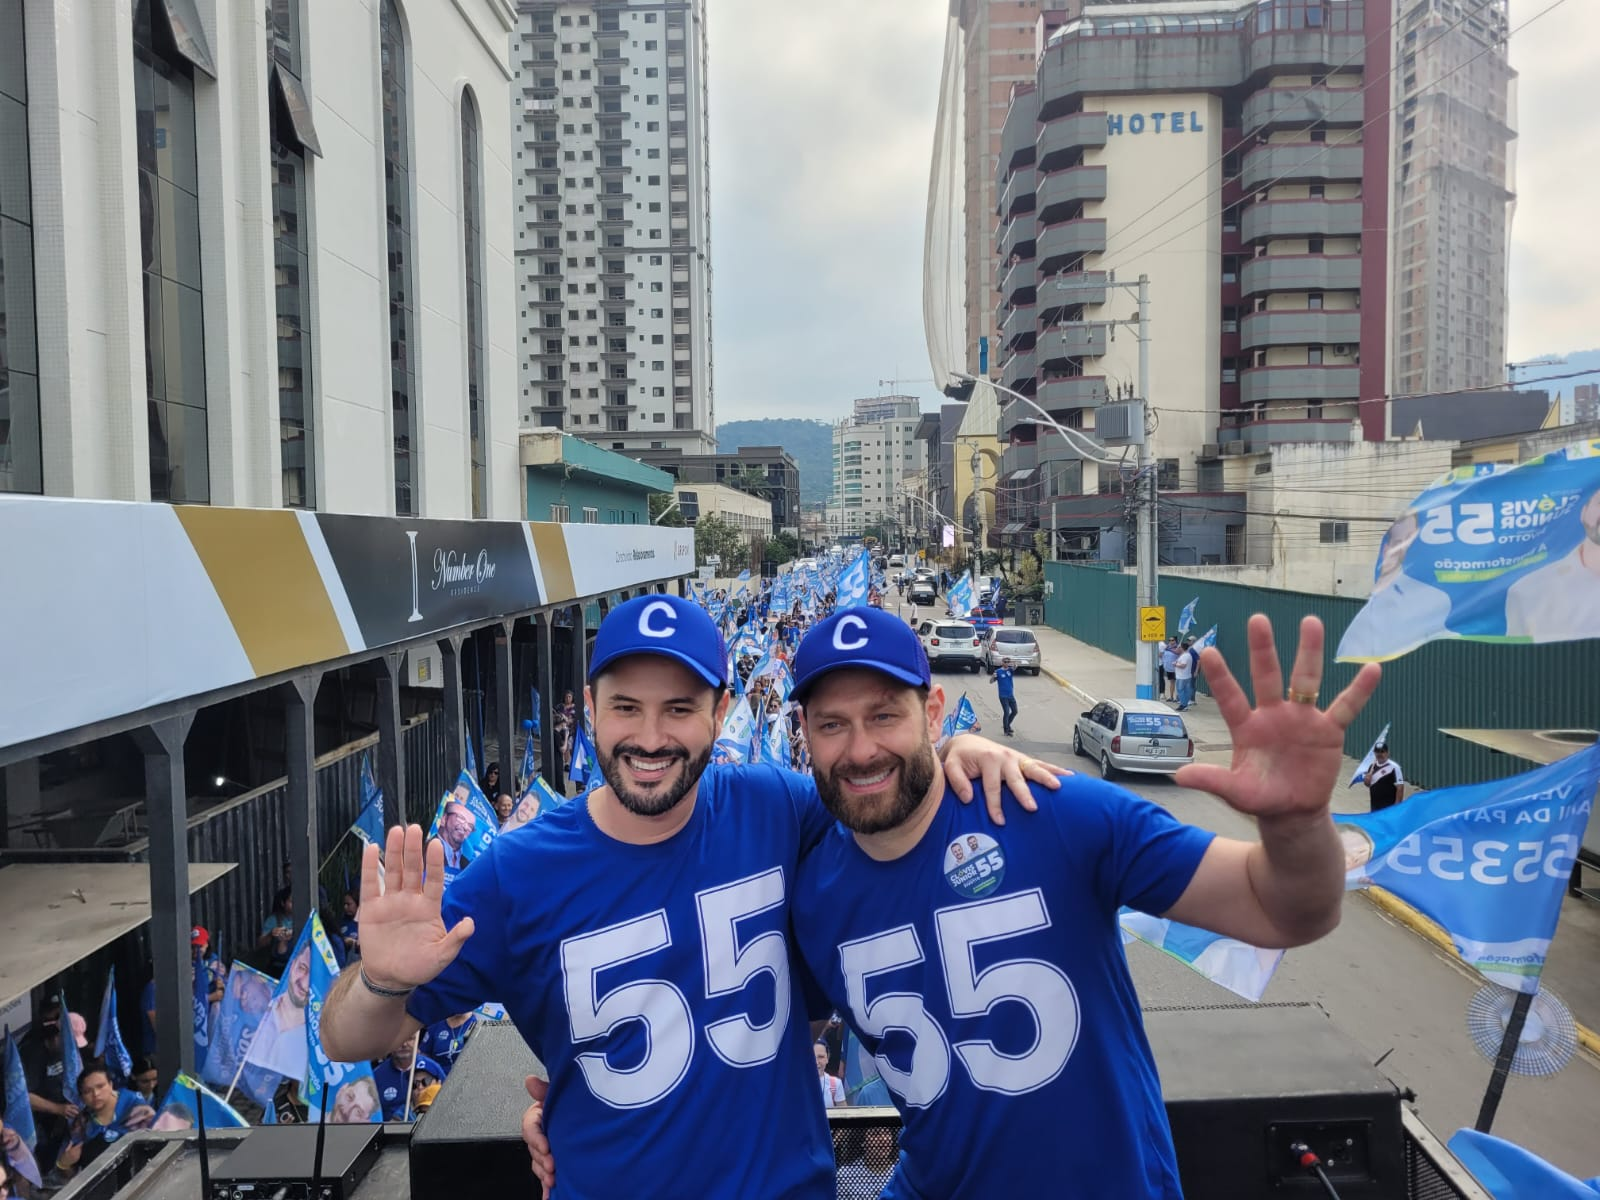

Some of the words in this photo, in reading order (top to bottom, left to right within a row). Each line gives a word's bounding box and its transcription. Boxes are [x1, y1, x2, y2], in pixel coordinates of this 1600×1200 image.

[1107, 111, 1203, 136] HOTEL
[431, 548, 475, 590] Number
[476, 549, 496, 584] One
[638, 601, 677, 638] C
[833, 615, 868, 650] C
[1146, 717, 1162, 727] 55
[975, 851, 1004, 878] 55
[560, 865, 790, 1110] 55
[838, 887, 1081, 1110] 55
